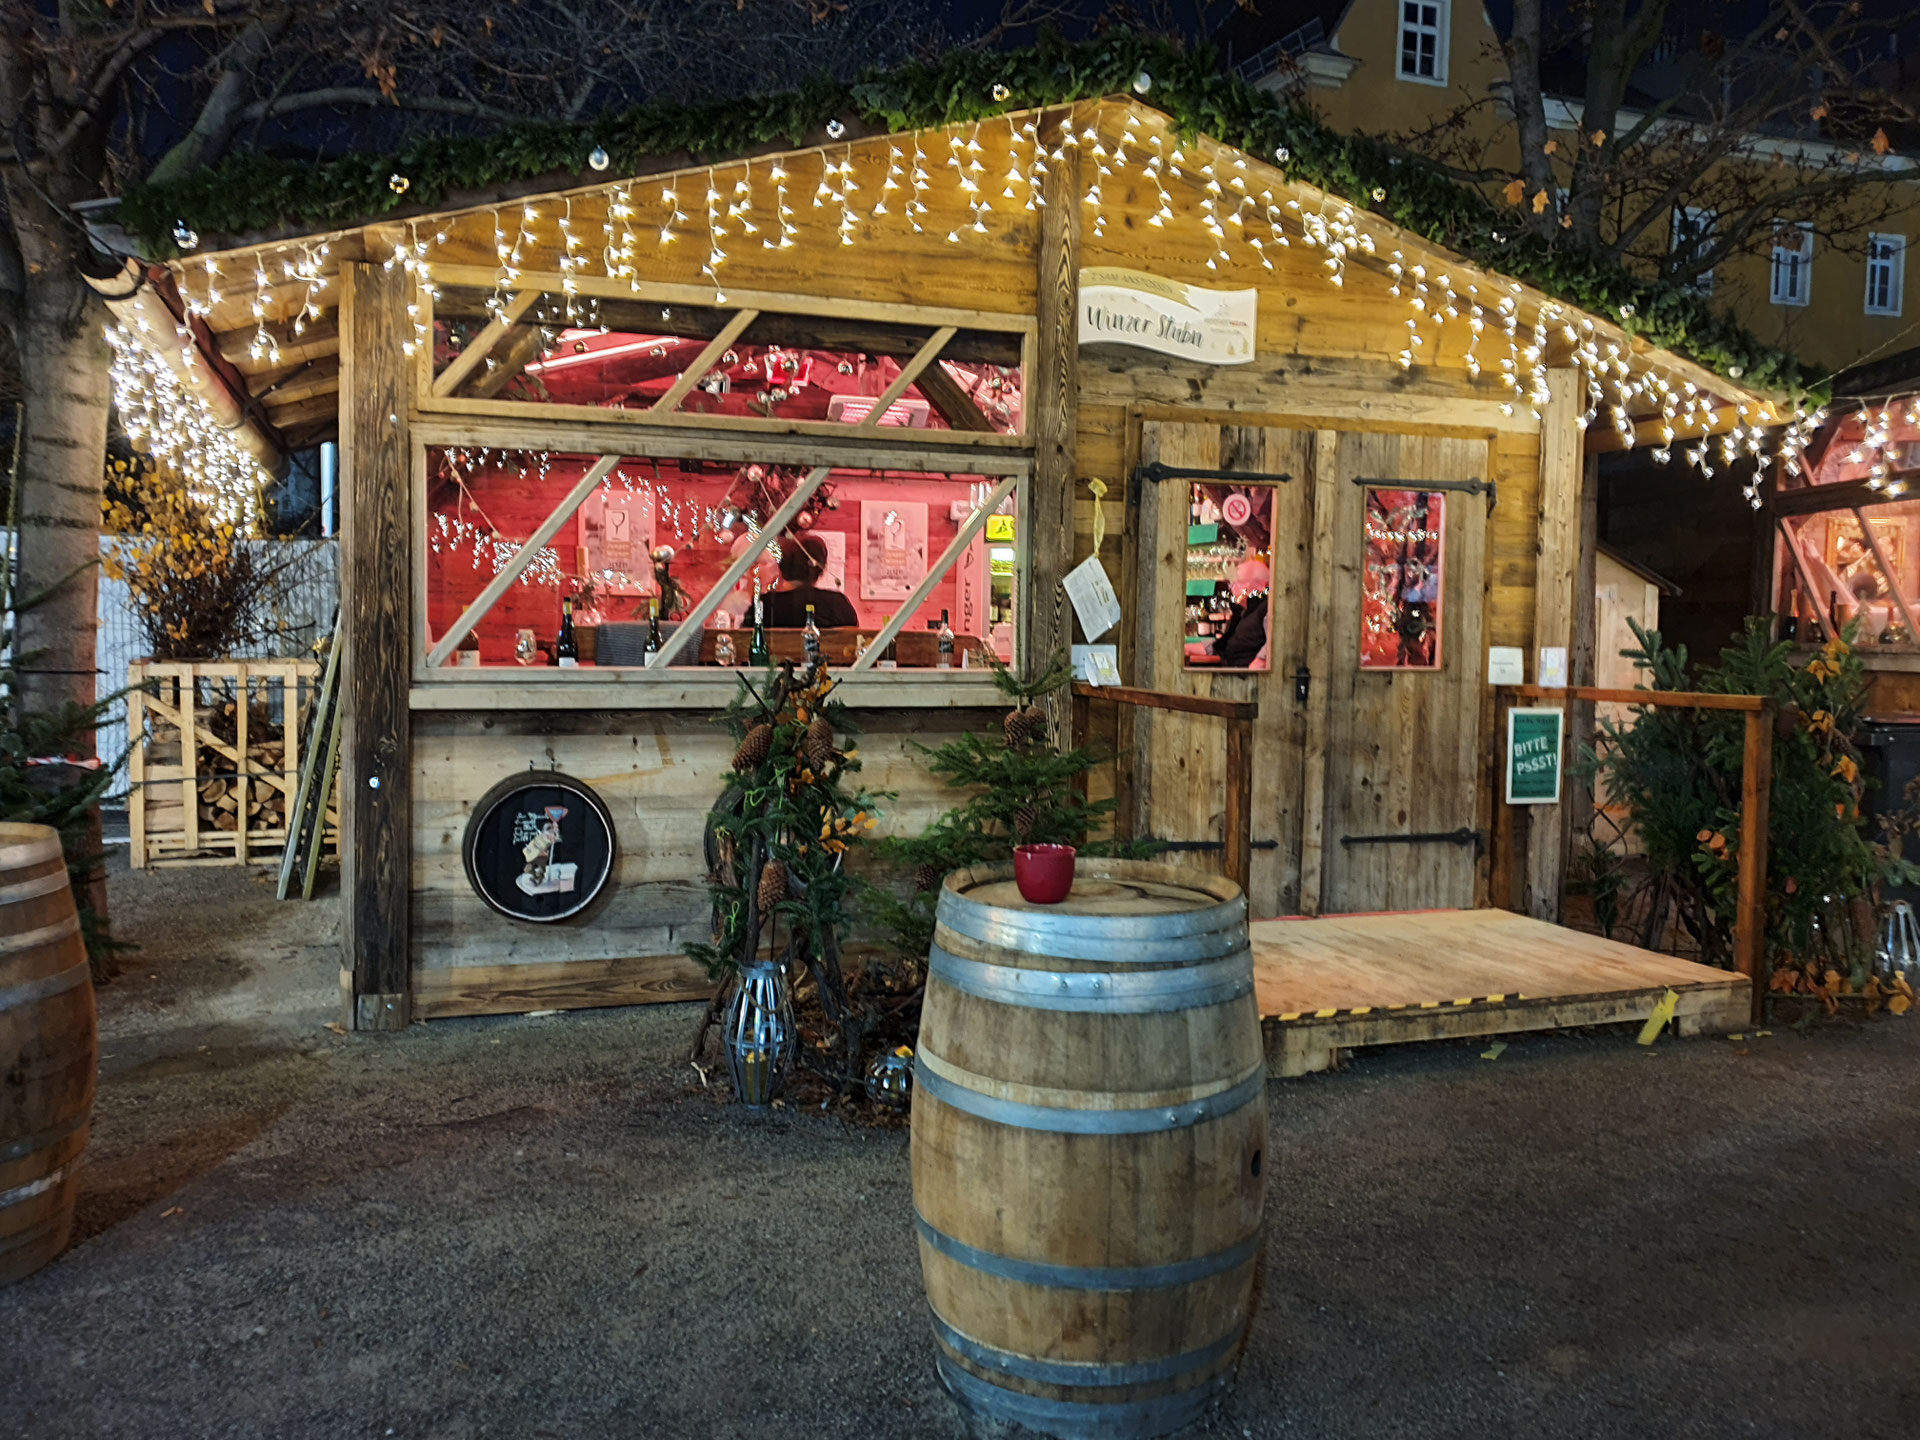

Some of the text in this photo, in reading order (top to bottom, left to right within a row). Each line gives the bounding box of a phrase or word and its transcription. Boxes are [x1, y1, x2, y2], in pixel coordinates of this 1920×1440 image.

[1086, 304, 1203, 348] Winzer Stubn
[1514, 735, 1548, 758] BITTE
[1516, 752, 1557, 776] PSSST!
